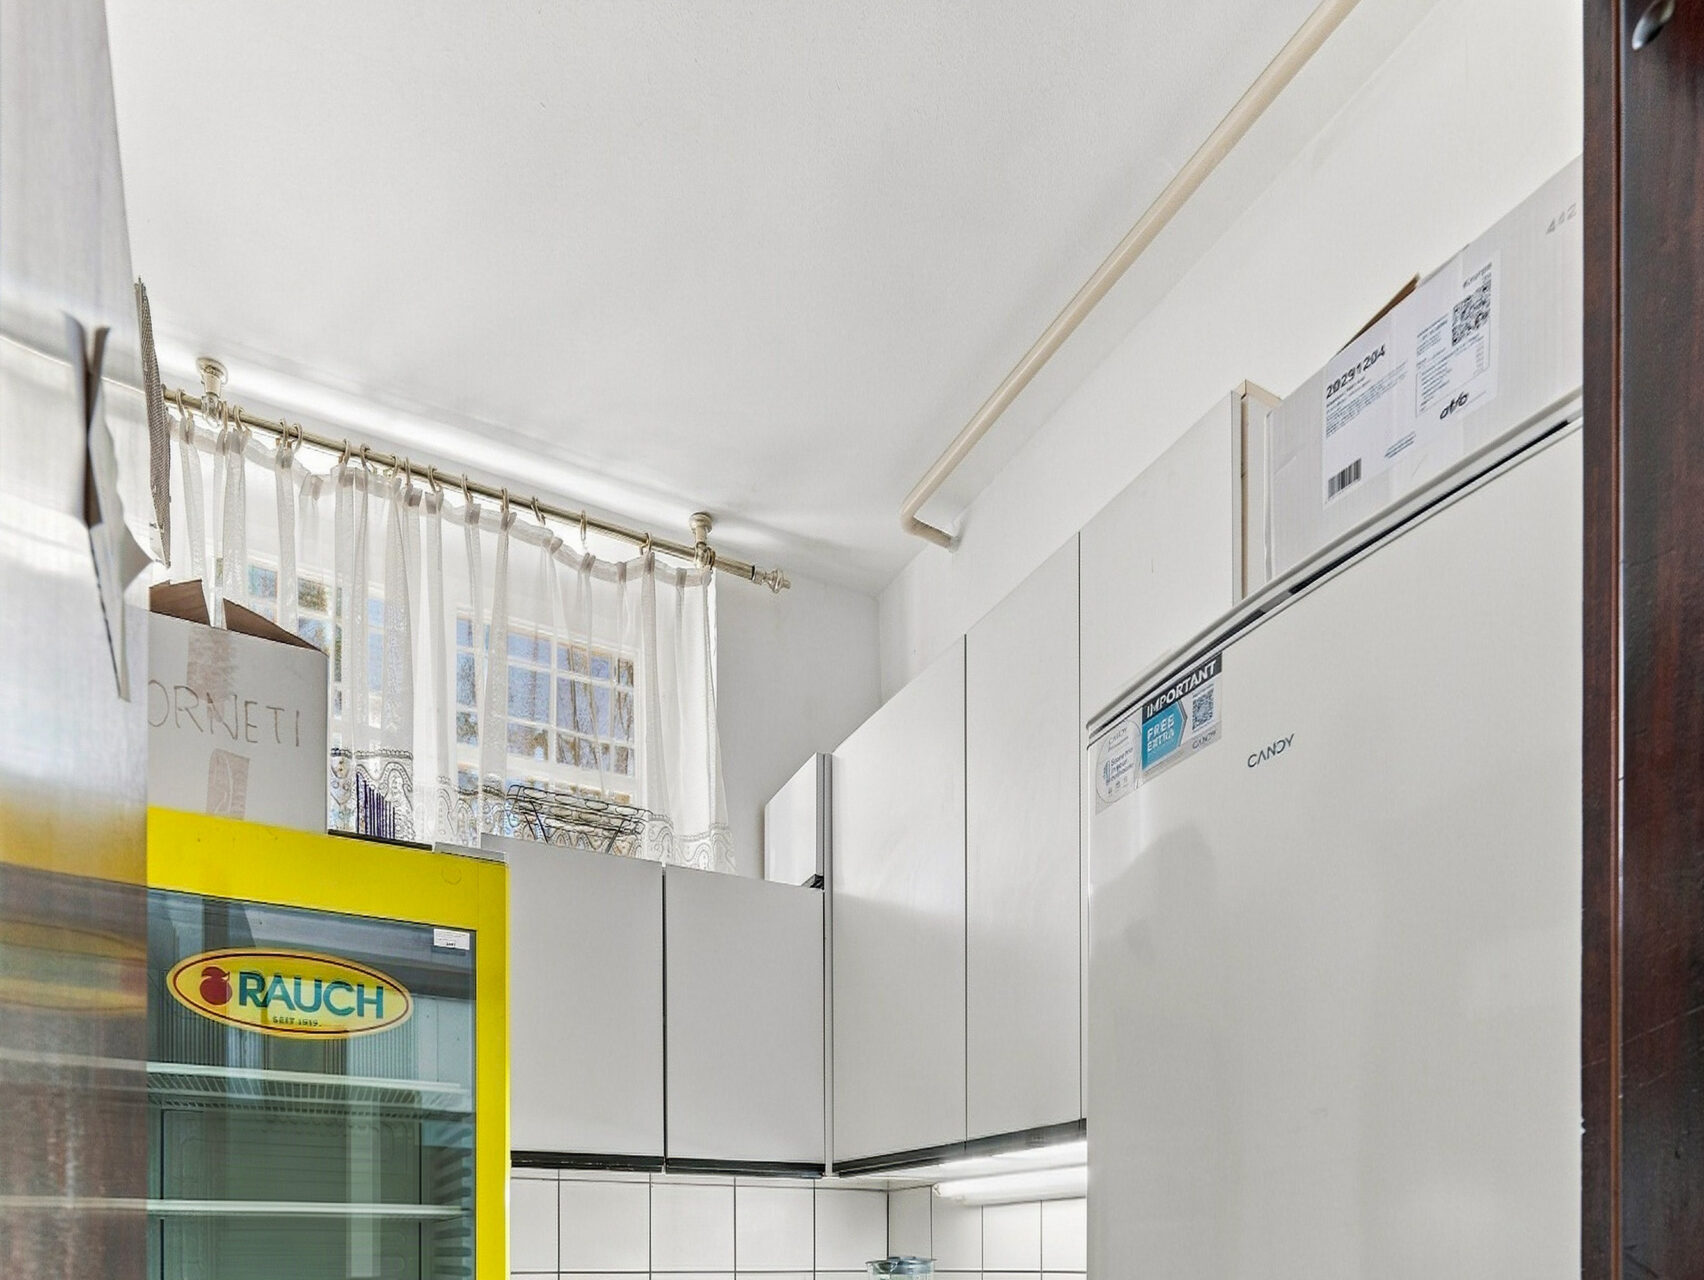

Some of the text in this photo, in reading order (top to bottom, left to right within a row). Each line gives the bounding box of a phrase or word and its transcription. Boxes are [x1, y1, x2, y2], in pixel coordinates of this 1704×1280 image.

[1147, 660, 1217, 718] IMPORTANT
[1147, 713, 1175, 741] FREE
[1147, 729, 1175, 752] EXTRA
[1247, 733, 1295, 769] CANDY
[239, 971, 384, 1019] RAUCH
